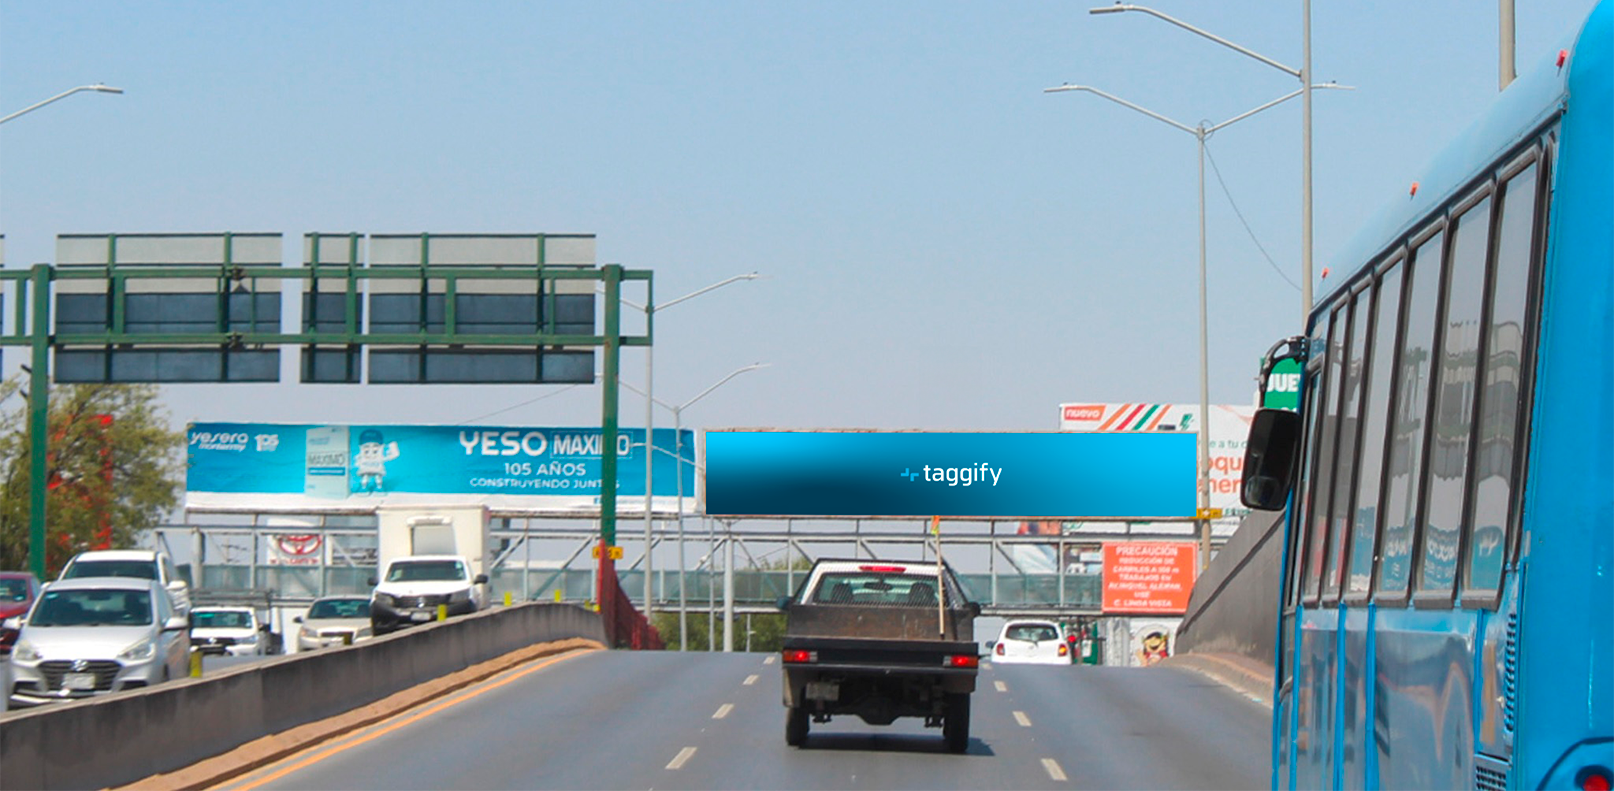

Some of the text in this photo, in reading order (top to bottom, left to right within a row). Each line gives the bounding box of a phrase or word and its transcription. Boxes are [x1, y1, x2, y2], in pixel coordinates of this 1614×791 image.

[1066, 408, 1100, 418] nuevo
[459, 431, 631, 456] YESO MAXIO
[505, 461, 587, 476] 105 AÑOS
[923, 462, 1002, 486] taggify
[470, 478, 620, 488] CONSTRUYENDO JUNTS
[1116, 544, 1178, 556] PRECAUCIÓN
